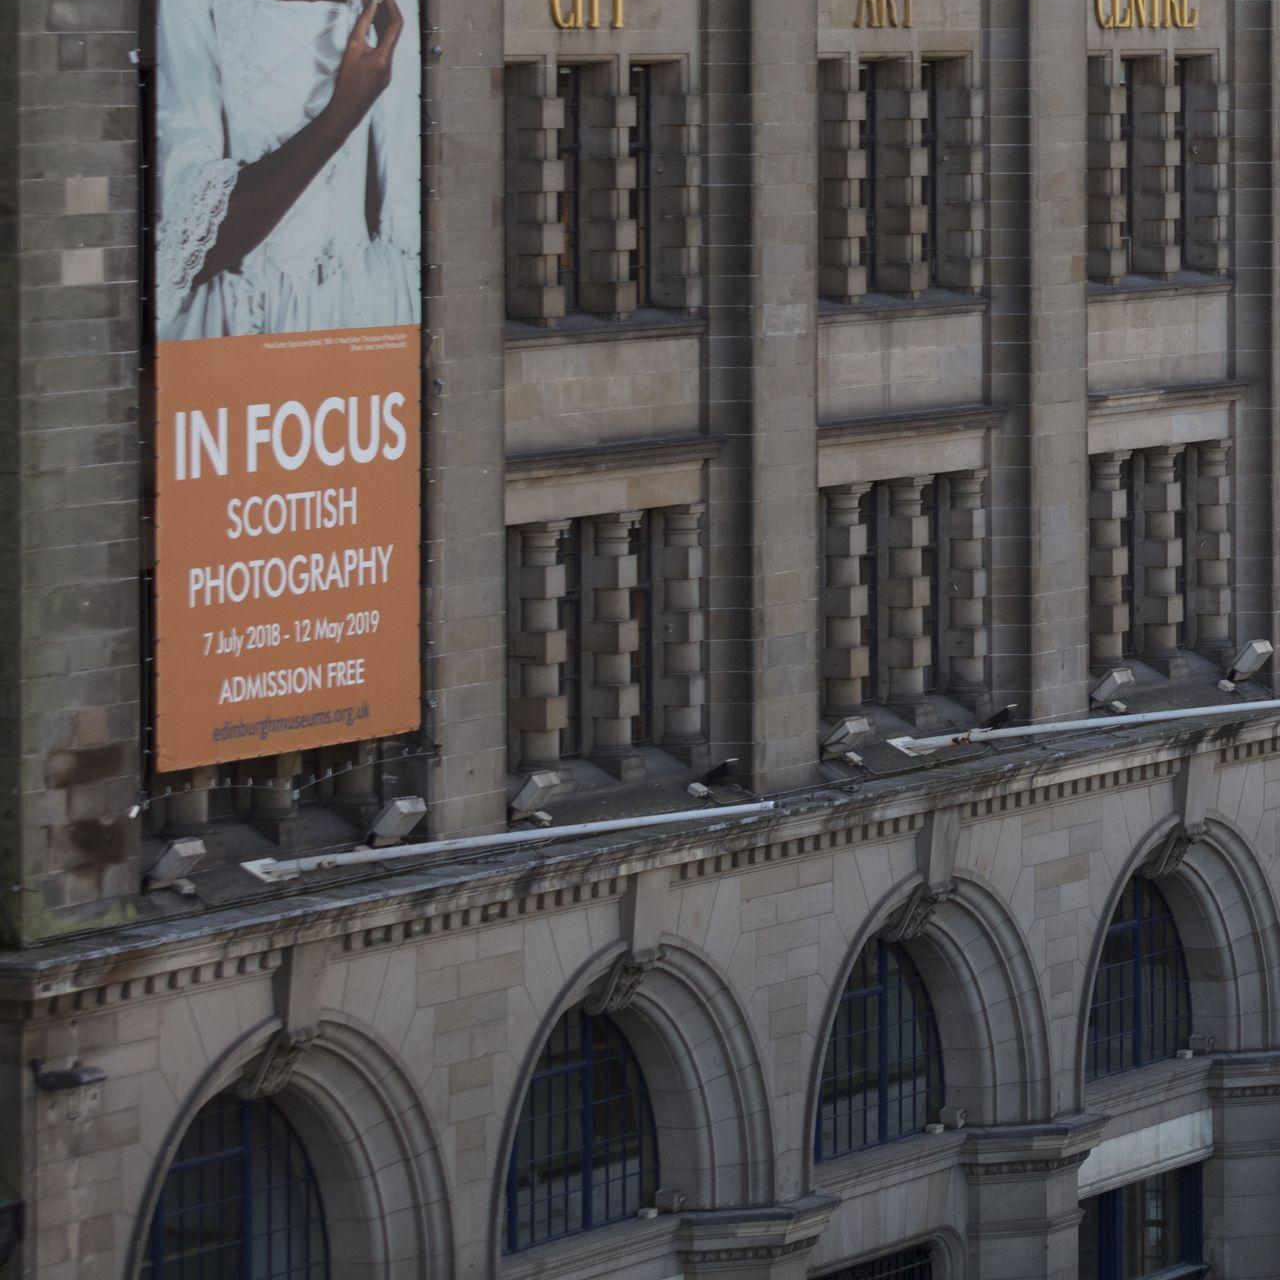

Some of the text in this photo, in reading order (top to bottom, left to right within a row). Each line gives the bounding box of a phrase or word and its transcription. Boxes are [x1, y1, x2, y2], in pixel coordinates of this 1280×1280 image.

[174, 391, 408, 480] IN FOCUS
[226, 487, 358, 540] SCOTTISH
[188, 545, 394, 609] PHOTOGRAPHY
[203, 632, 214, 656] 7
[215, 627, 244, 658] July
[246, 623, 281, 650] 2018
[294, 619, 312, 643] 12
[314, 617, 345, 644] May
[346, 610, 380, 637] 2019
[217, 658, 365, 705] ADMISSION FREE
[212, 699, 371, 741] edinburghmuseums.org.uk
